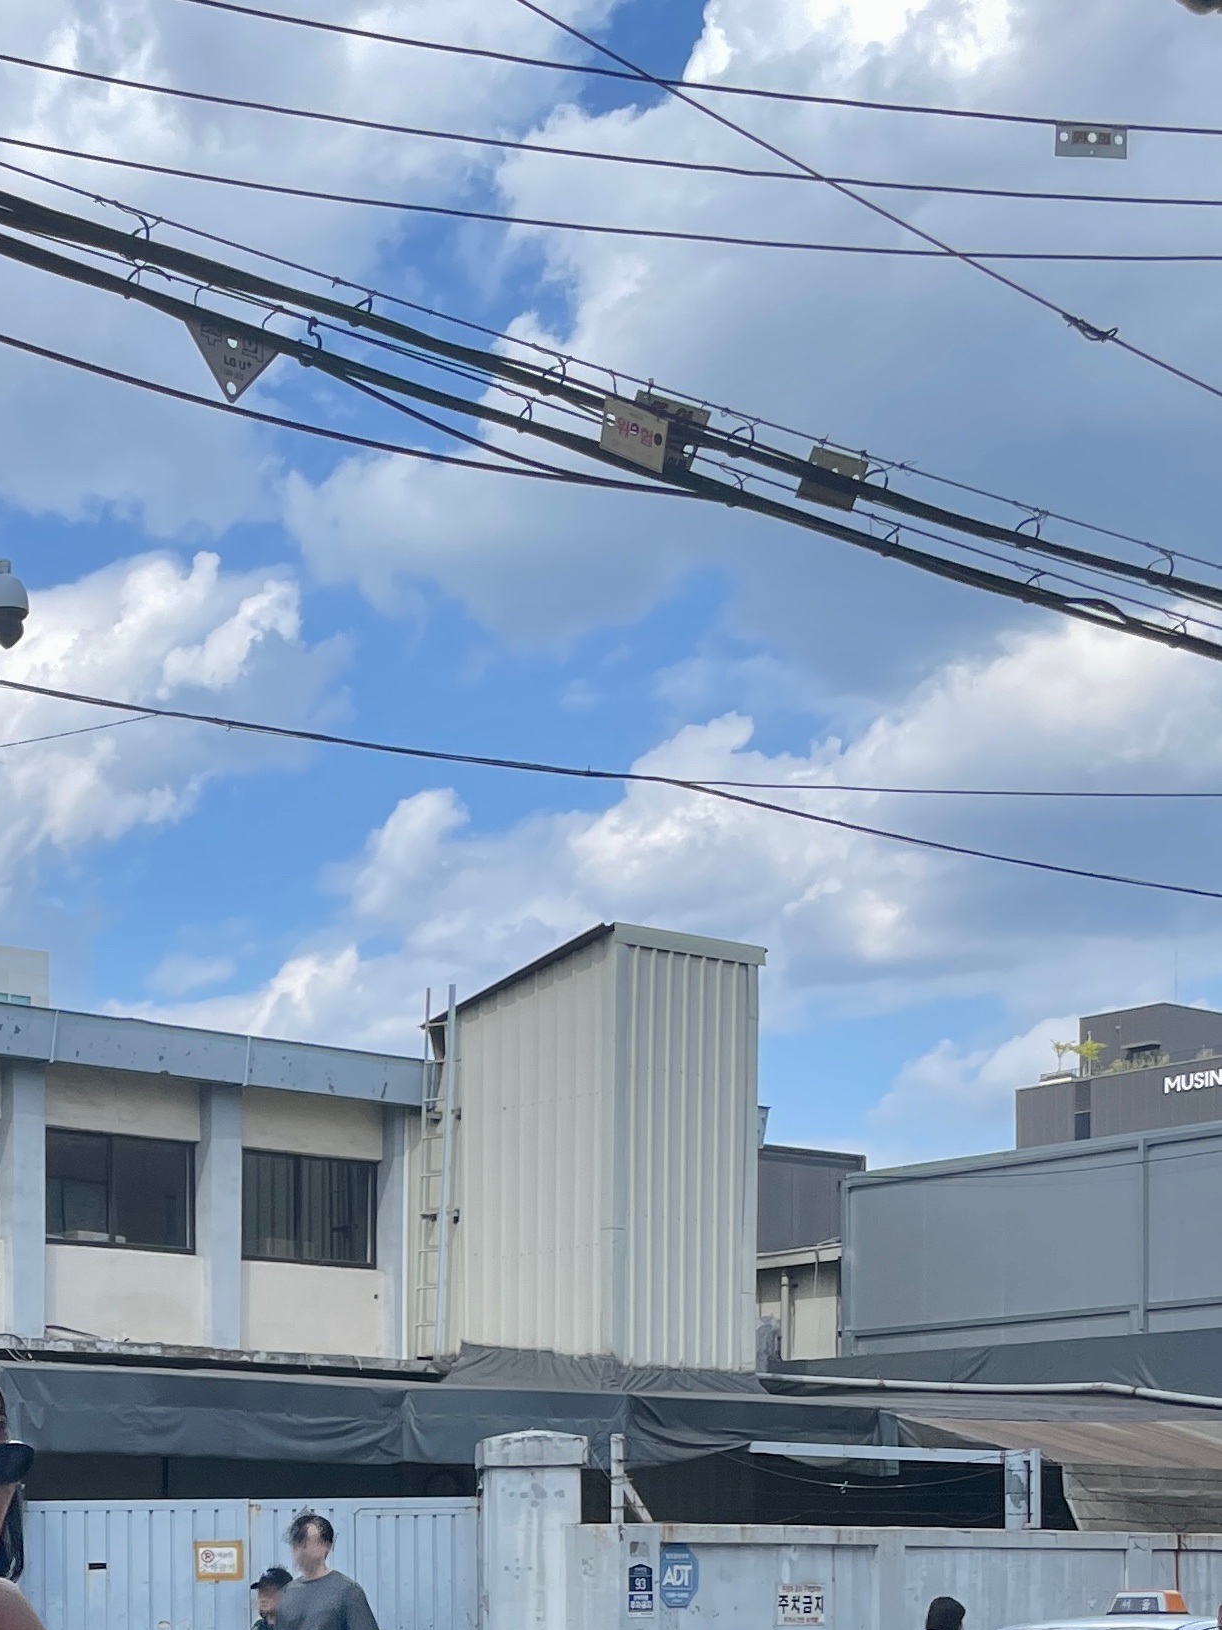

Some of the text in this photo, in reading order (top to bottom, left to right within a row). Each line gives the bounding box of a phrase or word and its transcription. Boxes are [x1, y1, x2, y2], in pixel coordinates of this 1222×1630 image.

[223, 354, 237, 368] LG
[1163, 1068, 1222, 1095] MUSIN
[634, 1577, 647, 1591] 93
[661, 1564, 693, 1587] ADT
[777, 1595, 824, 1614] 주차금지
